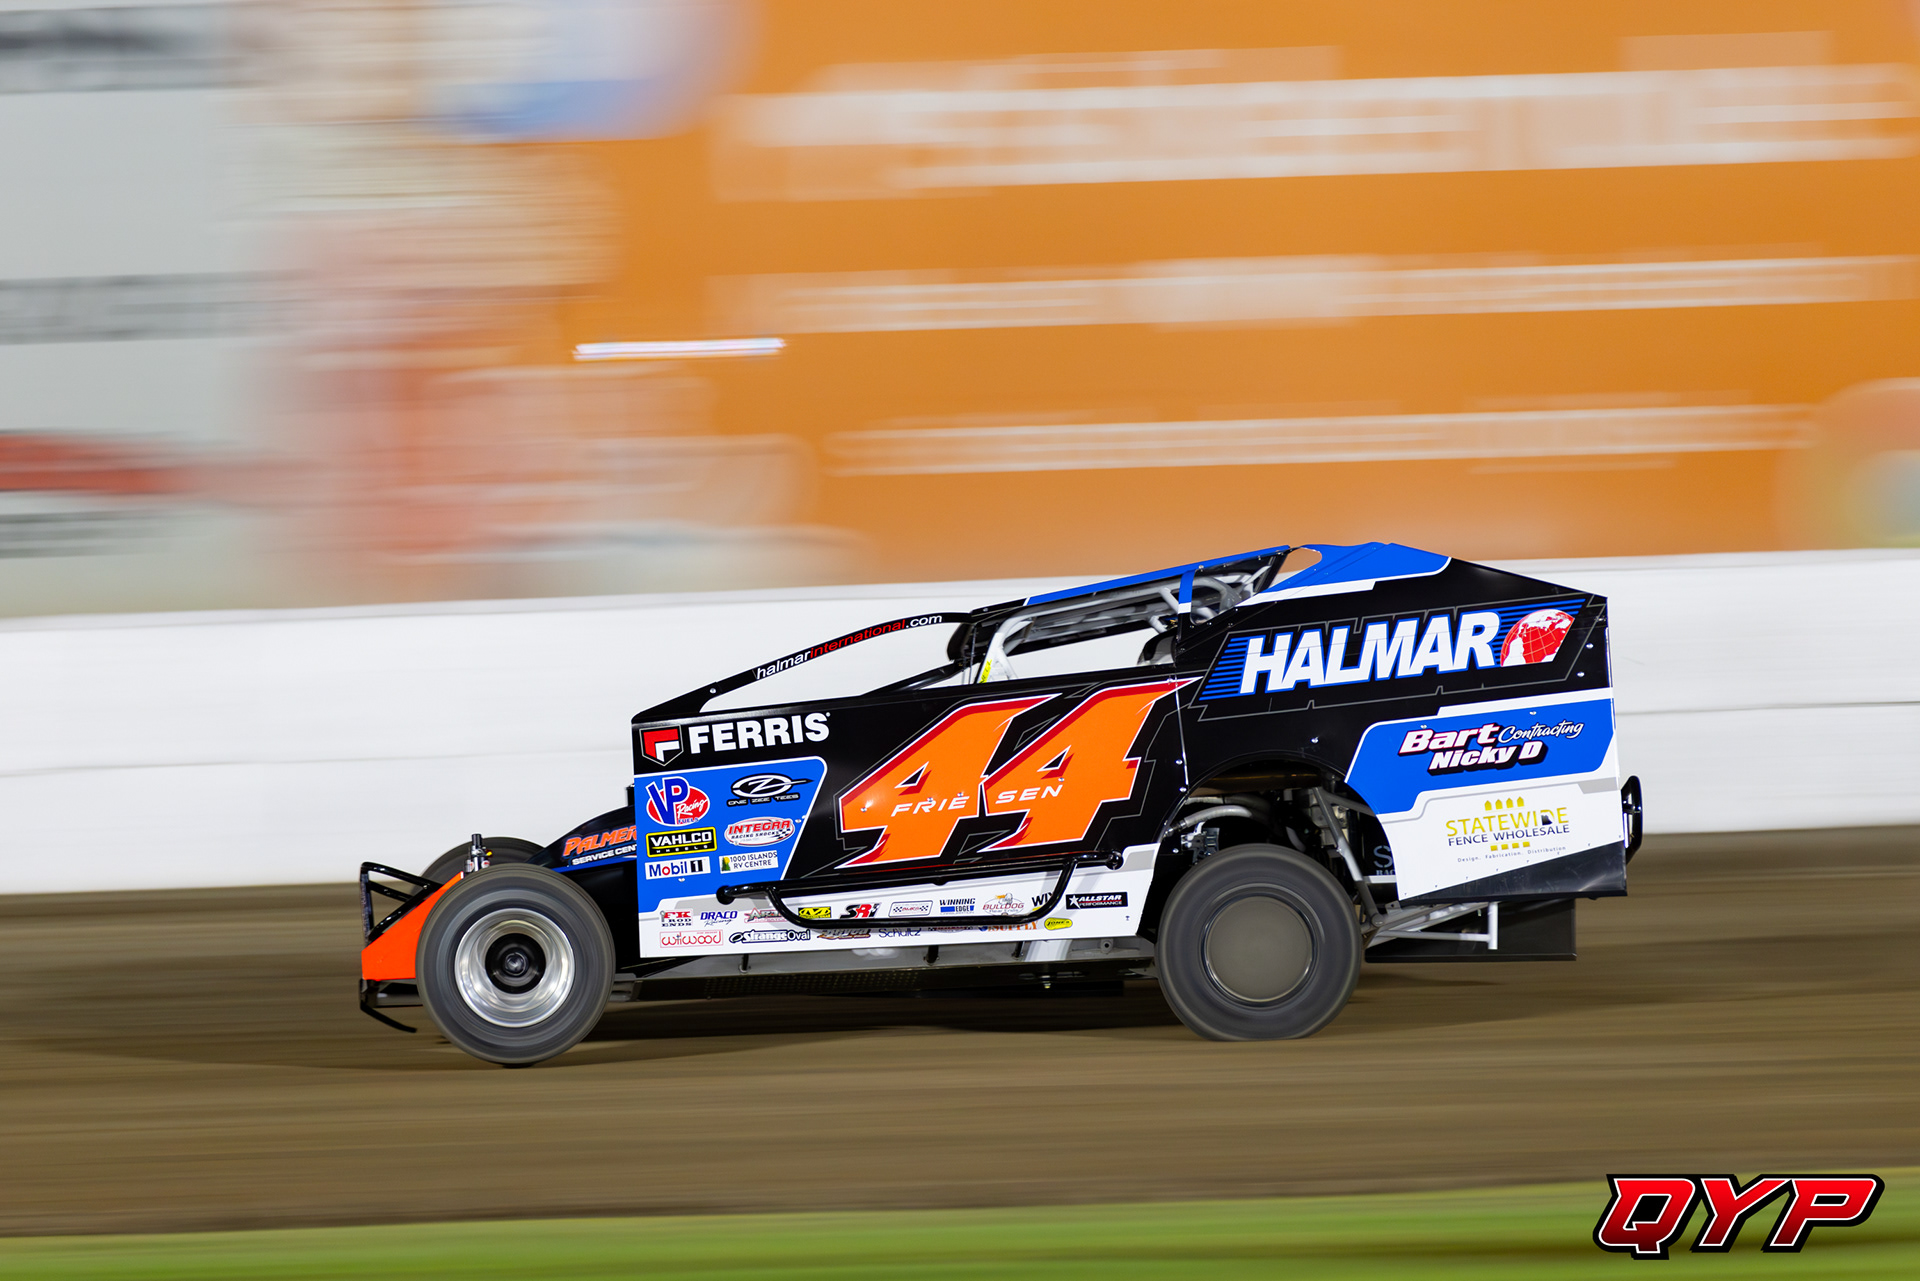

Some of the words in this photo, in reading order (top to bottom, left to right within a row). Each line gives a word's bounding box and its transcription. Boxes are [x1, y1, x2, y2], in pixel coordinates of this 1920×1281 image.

[756, 613, 943, 680] halmarinternational.com
[1239, 609, 1501, 695] HALMAR
[688, 712, 830, 754] FERRIS
[1398, 723, 1501, 755] Bart
[1497, 719, 1585, 743] Contracting
[1428, 743, 1516, 772] Nicky
[1517, 740, 1545, 762] D
[834, 677, 1201, 869] 44
[645, 776, 691, 826] VP
[774, 793, 799, 801] TEES
[676, 797, 708, 816] Racing
[677, 817, 699, 825] FUELS
[728, 820, 791, 835] INTEGRA
[1445, 806, 1570, 837] STATEWIDE
[650, 831, 712, 847] VAHLCO
[1448, 834, 1489, 846] FENCE
[1493, 824, 1570, 841] WHOLESALE
[571, 849, 615, 866] SERVICE
[730, 854, 747, 863] 1000
[748, 851, 778, 861] ISLANDS
[1527, 845, 1567, 855] Distribution
[649, 860, 688, 877] Mobil
[691, 860, 701, 872] 1
[744, 859, 772, 868] CENTRE
[939, 898, 976, 906] WINNING
[982, 902, 1025, 911] BULLDOG
[1078, 894, 1122, 902] ALLSTAR
[700, 910, 738, 921] DRACO
